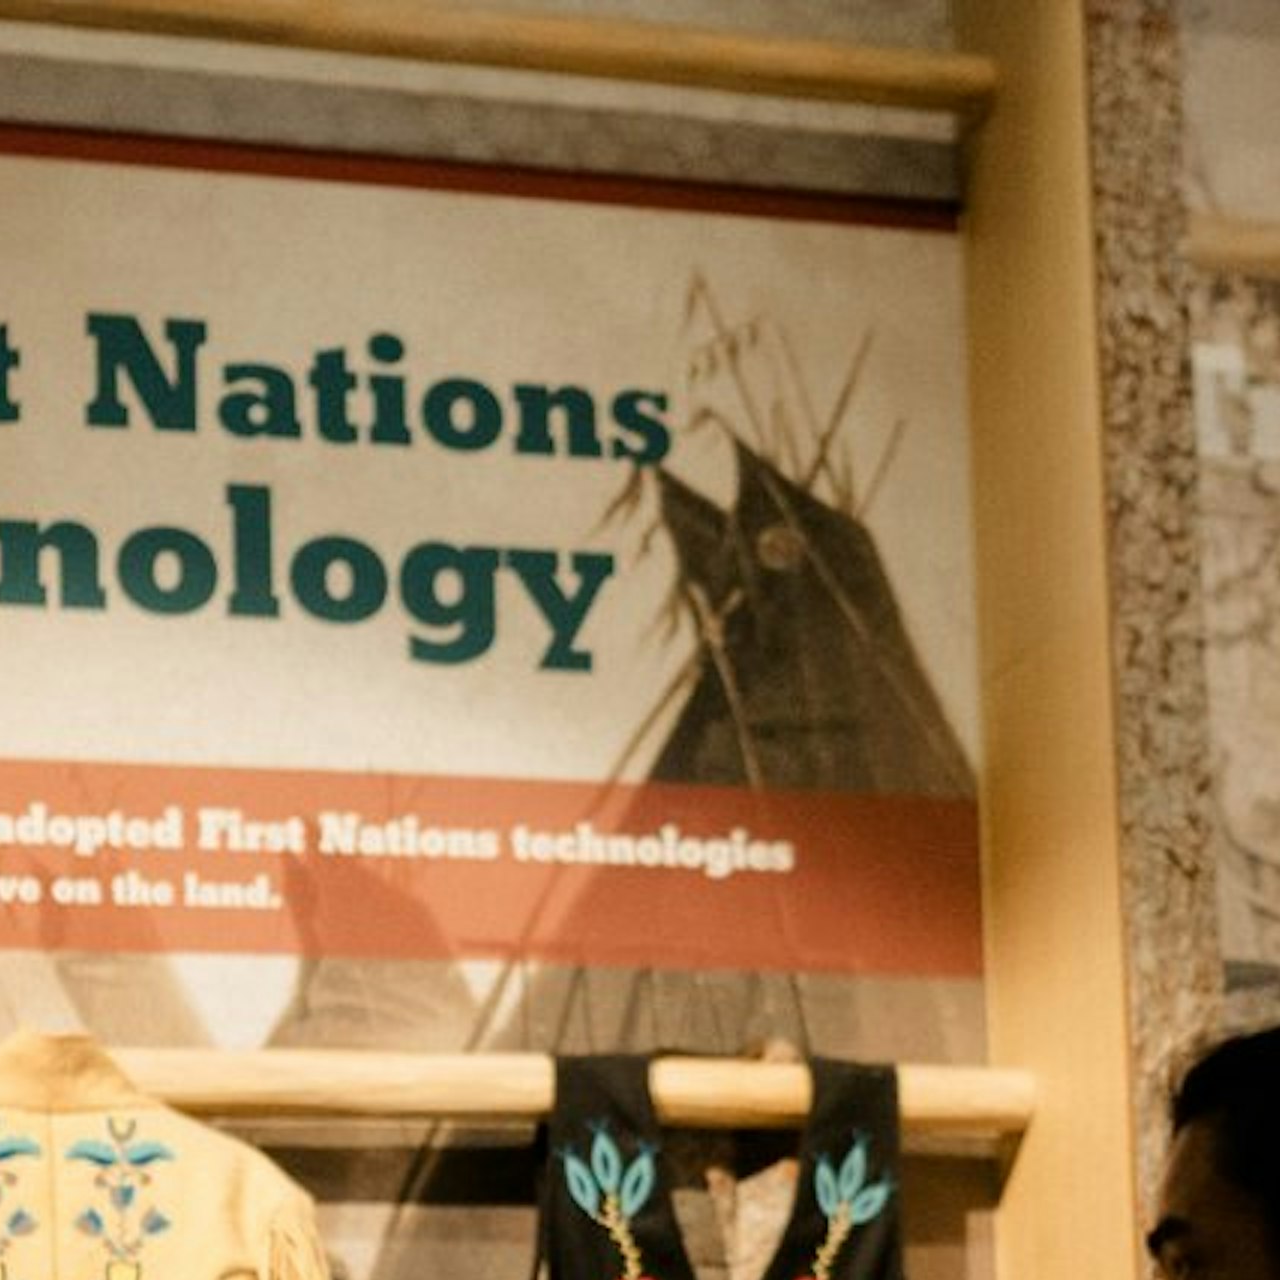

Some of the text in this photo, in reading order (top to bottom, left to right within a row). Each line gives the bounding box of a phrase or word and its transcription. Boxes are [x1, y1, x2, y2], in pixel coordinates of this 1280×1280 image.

[84, 312, 672, 467] Nations
[197, 807, 306, 854] First
[318, 811, 500, 860] Nations
[510, 821, 795, 880] technologies
[51, 874, 102, 905] on
[111, 870, 174, 908] the
[183, 872, 283, 910] land.
